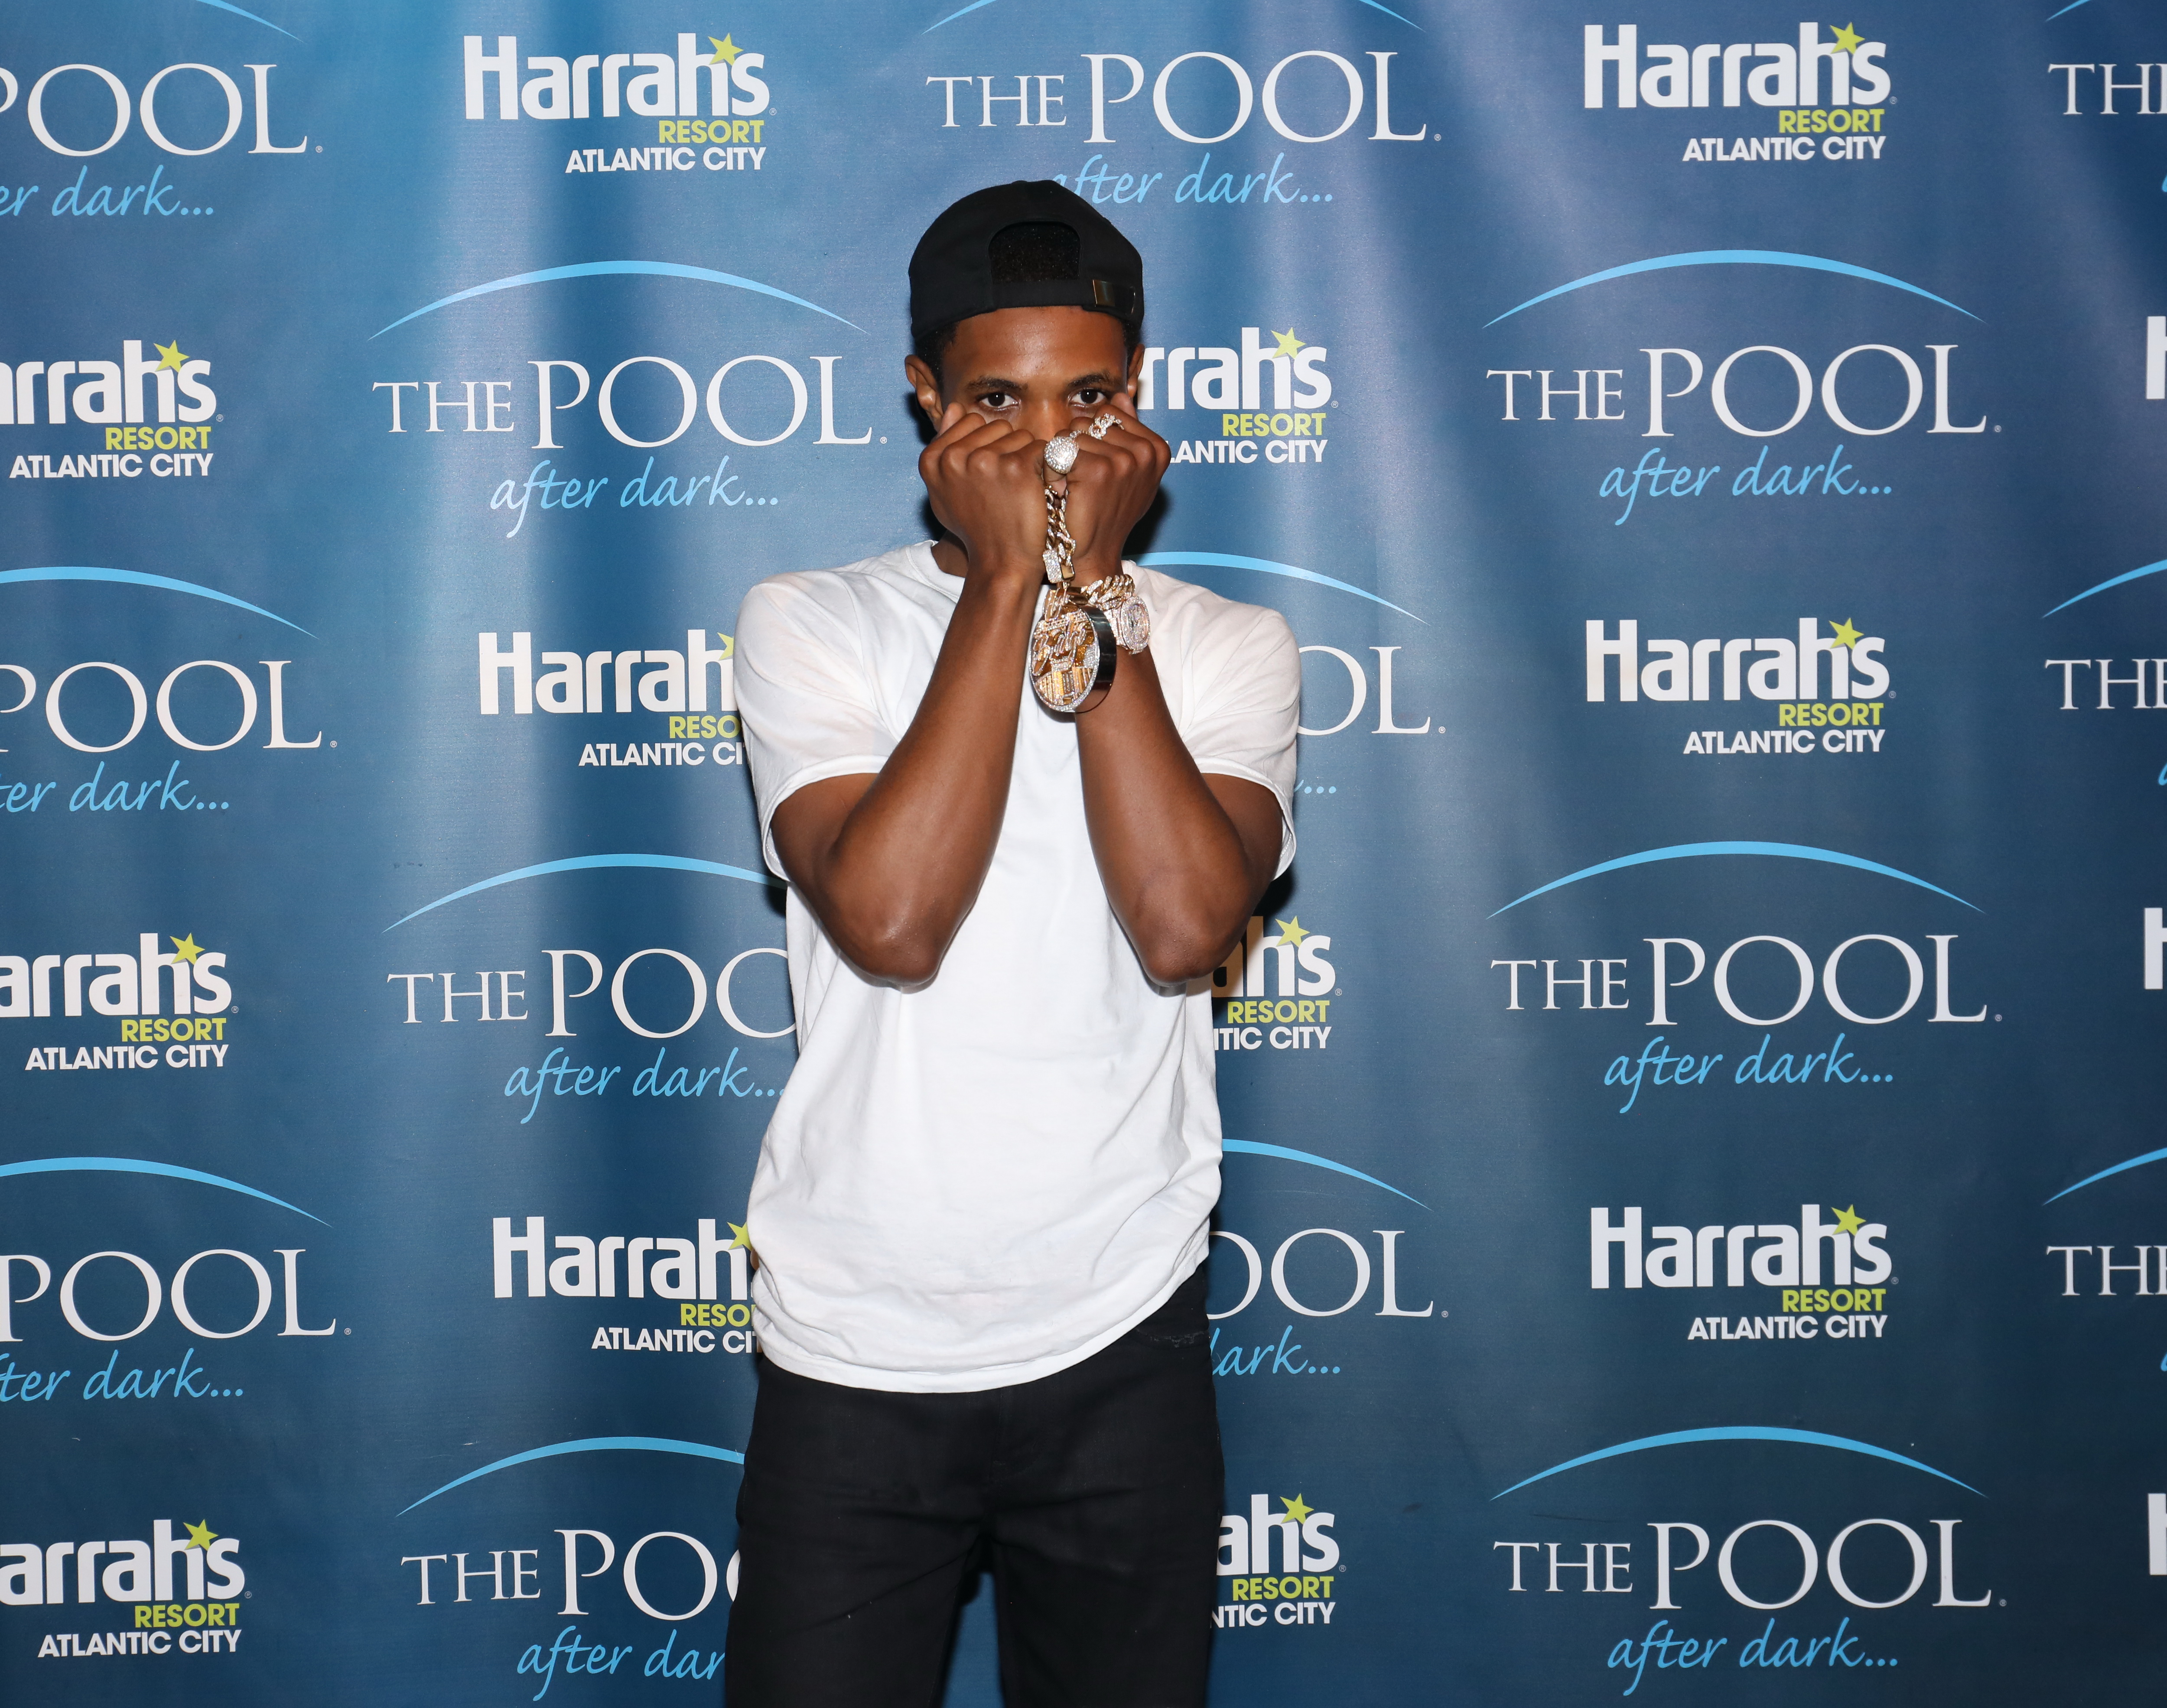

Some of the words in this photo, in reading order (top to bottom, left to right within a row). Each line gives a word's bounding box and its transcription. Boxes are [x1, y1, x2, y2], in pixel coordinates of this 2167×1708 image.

[0, 63, 307, 156] OOL
[926, 75, 1066, 127] THE
[1081, 51, 1426, 143] POOL
[660, 120, 764, 143] RESORT
[1780, 109, 1885, 133] RESORT
[566, 147, 695, 173] ATLANTIC
[703, 147, 766, 170] CITY
[1682, 137, 1815, 161] ATLANTIC
[1822, 136, 1886, 160] CITY
[52, 165, 213, 216] dark...
[1175, 153, 1332, 203] dark...
[373, 381, 514, 432] THE
[527, 355, 872, 448] POOL
[1487, 370, 1624, 419] THE
[1640, 344, 1986, 436] POOL
[107, 426, 208, 450] RESORT
[1223, 414, 1327, 436] RESORT
[1165, 440, 1258, 463] ANTIC
[1265, 440, 1328, 463] CITY
[10, 454, 142, 478] ATLANTIC
[150, 453, 213, 477] CITY
[490, 460, 608, 538] after
[621, 455, 778, 507] dark...
[1600, 448, 1720, 525] after
[1732, 445, 1891, 496] dark...
[1296, 646, 1430, 735] OL
[669, 716, 740, 738] RESO
[1780, 703, 1884, 726] RESORT
[579, 742, 705, 766] ATLANTIC
[713, 742, 745, 765] CI
[1683, 730, 1815, 753] ATLANTIC
[1823, 730, 1885, 753] CITY
[69, 760, 228, 811] dark...
[387, 971, 527, 1023] THE
[542, 948, 796, 1038] POO
[1491, 959, 1629, 1009] THE
[1643, 935, 1987, 1025] POOL
[1227, 1000, 1330, 1024] RESORT
[122, 1018, 226, 1041] RESORT
[1270, 1026, 1331, 1049] CITY
[25, 1046, 158, 1070] ATLANTIC
[166, 1045, 228, 1068] CITY
[504, 1047, 621, 1124] after
[1604, 1036, 1723, 1113] after
[1735, 1033, 1893, 1084] dark...
[1208, 1228, 1432, 1319] OOL
[0, 1249, 335, 1341] POOL
[1783, 1289, 1886, 1312] RESORT
[680, 1304, 756, 1327] RESO
[1688, 1316, 1818, 1340] ATLANTIC
[1825, 1315, 1887, 1338] CITY
[592, 1328, 715, 1353] ATLANTIC
[722, 1330, 762, 1354] CIT
[0, 1353, 70, 1402] ter
[84, 1348, 243, 1400] dark...
[401, 1549, 540, 1604] THE
[554, 1530, 740, 1620] PO
[1494, 1542, 1632, 1592] THE
[1647, 1519, 1991, 1609] POOL
[1233, 1576, 1334, 1600] RESORT
[135, 1603, 239, 1627] RESORT
[1275, 1602, 1335, 1624] CITY
[38, 1631, 171, 1657] ATLANTIC
[179, 1630, 241, 1653] CITY
[1608, 1620, 1727, 1696] after
[1740, 1617, 1897, 1667] dark...
[517, 1626, 632, 1701] after
[644, 1629, 725, 1679] dar
